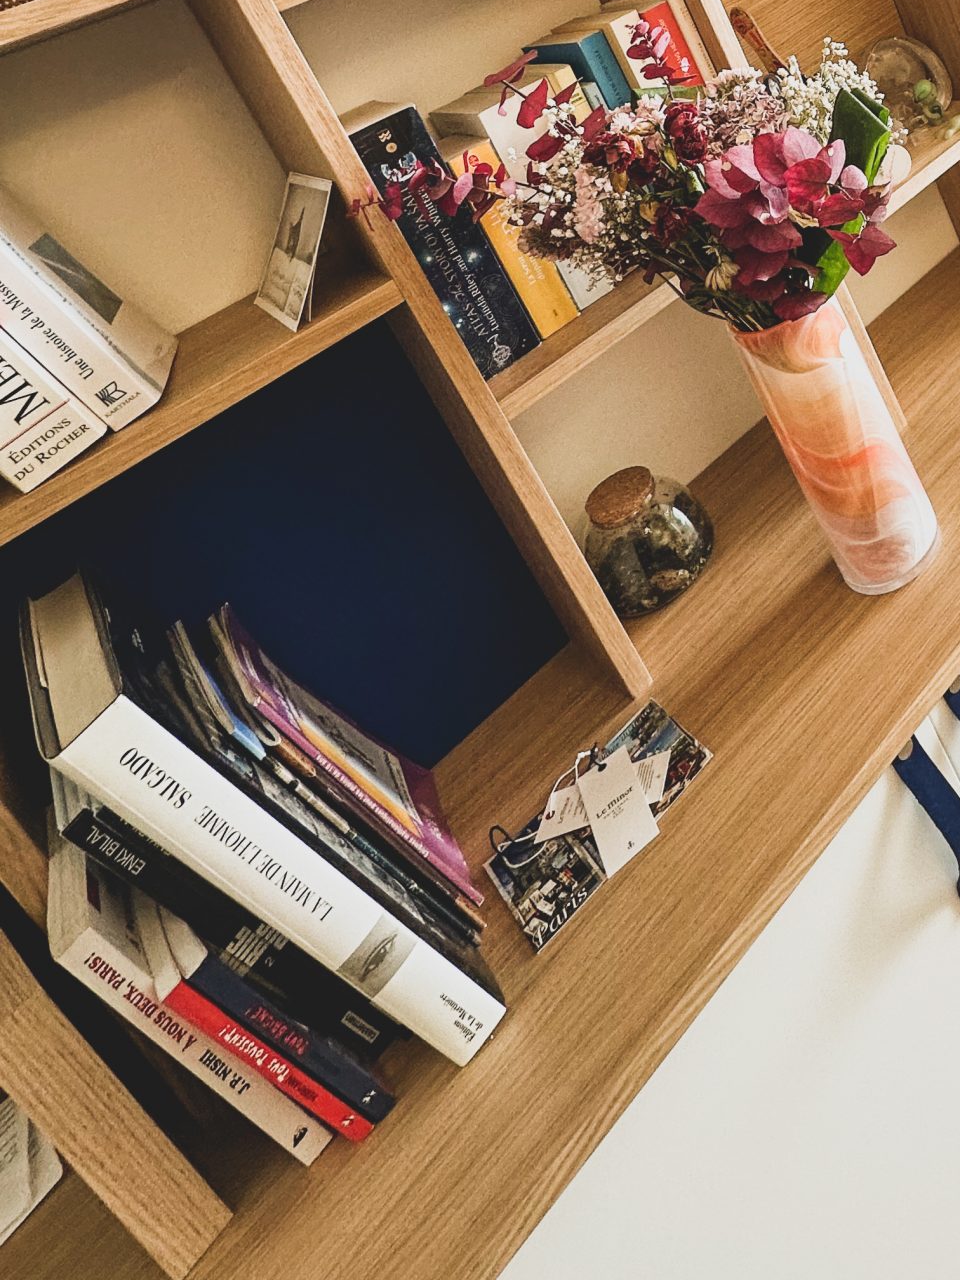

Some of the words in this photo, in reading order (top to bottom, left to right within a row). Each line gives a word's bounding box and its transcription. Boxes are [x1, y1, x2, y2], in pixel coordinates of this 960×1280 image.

[413, 213, 429, 231] PA
[422, 230, 439, 248] OF
[434, 224, 461, 255] Harry
[430, 246, 460, 283] STORY
[451, 253, 469, 274] and
[460, 270, 484, 298] Riley
[17, 306, 33, 323] la
[27, 315, 46, 333] de
[460, 302, 488, 338] ATLAS
[472, 293, 504, 332] Lucinda
[38, 326, 77, 365] histoire
[71, 357, 94, 380] Une
[104, 391, 141, 419] KARTHALA
[7, 417, 72, 465] ÉDITIONS
[14, 463, 35, 482] DU
[35, 423, 91, 464] ROCHER
[115, 743, 196, 812] SALGADO
[594, 806, 608, 820] Le
[606, 783, 635, 809] Minor
[82, 823, 120, 858] BILAL
[190, 803, 265, 867] L'HOMME
[113, 845, 146, 876] ENKI
[253, 852, 283, 882] DE
[271, 867, 316, 908] MAIN
[308, 895, 335, 923] LA
[527, 885, 592, 949] Paris
[82, 950, 127, 991] PARIS!
[119, 979, 161, 1019] DEUX,
[436, 988, 469, 1022] Martinière
[152, 1009, 183, 1039] NOUS
[450, 1017, 476, 1044] Éditions
[464, 1012, 478, 1025] La
[472, 1019, 484, 1031] de
[175, 1030, 198, 1054] À
[216, 1019, 270, 1068] TOUSSENT!
[197, 1047, 234, 1081] NISHI
[266, 1056, 291, 1080] TOUS
[226, 1071, 252, 1097] J.P.
